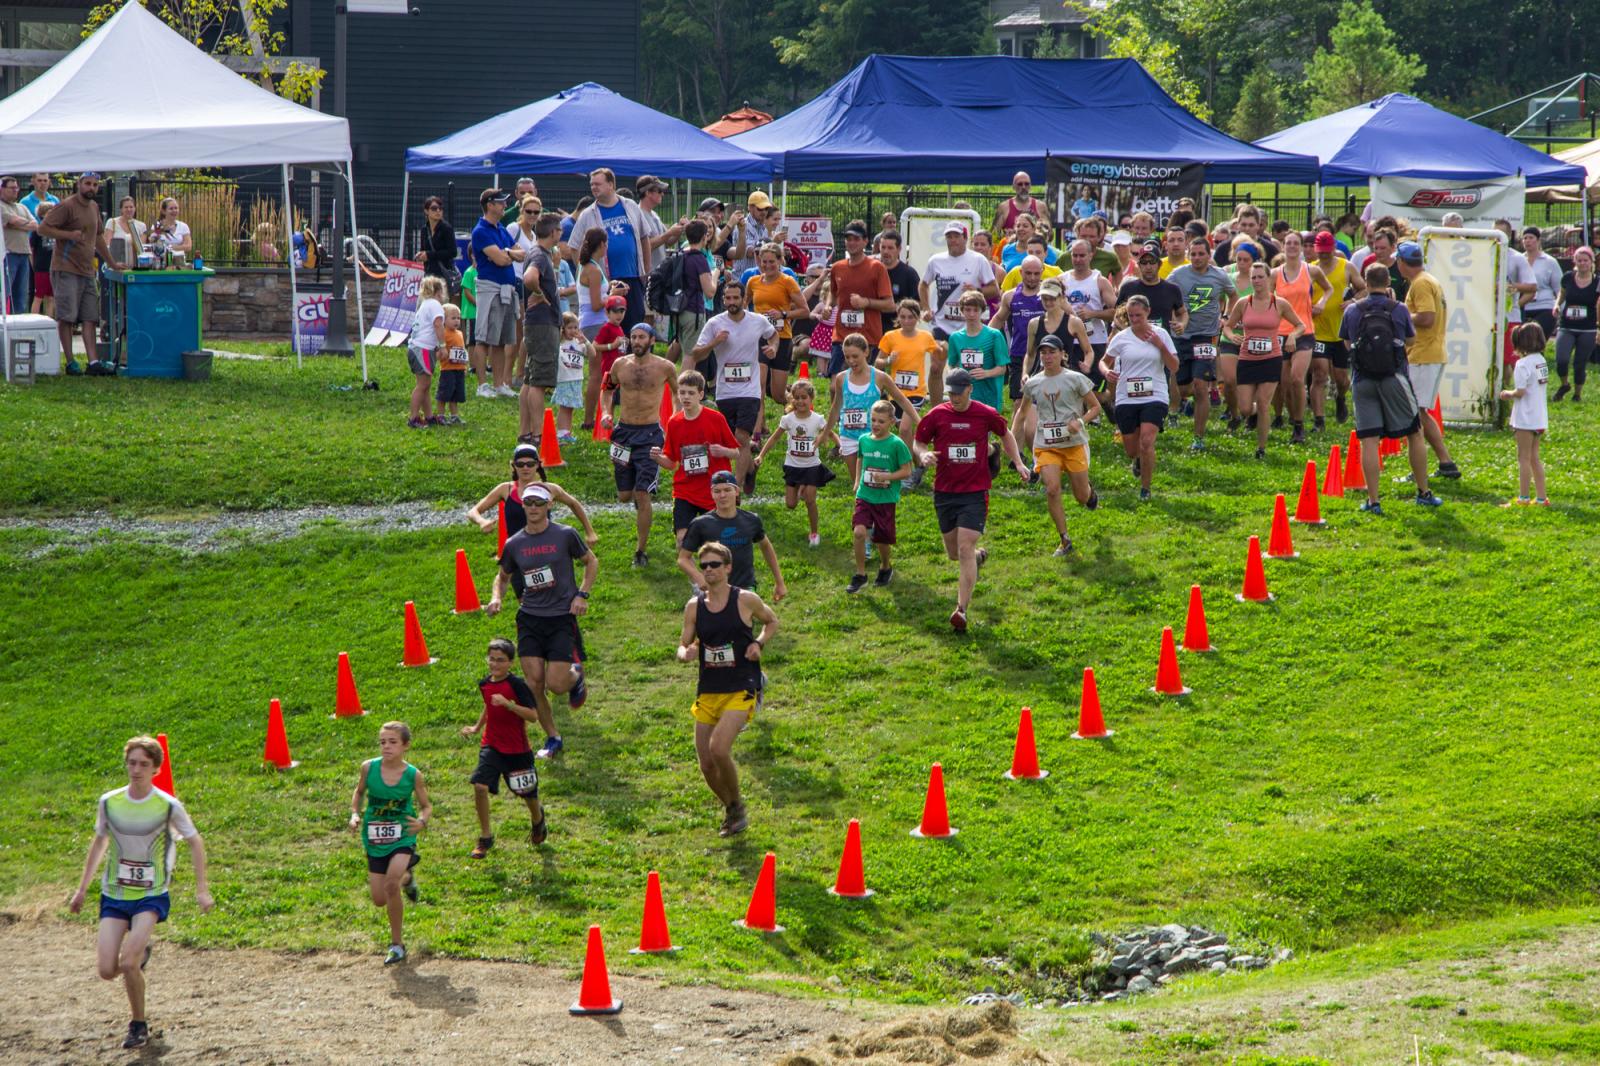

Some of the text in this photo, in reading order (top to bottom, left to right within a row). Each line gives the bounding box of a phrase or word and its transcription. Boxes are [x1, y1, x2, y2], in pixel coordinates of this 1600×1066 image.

[1071, 162, 1182, 179] energybits.com
[1132, 196, 1180, 214] bette
[1411, 191, 1473, 208] 2Toms
[800, 222, 817, 233] 60
[386, 275, 404, 294] GU
[1198, 346, 1213, 355] 142
[1252, 341, 1267, 351] 141
[567, 353, 581, 364] 122
[966, 354, 975, 363] 21
[731, 367, 742, 377] 41
[901, 375, 912, 384] 17
[1133, 382, 1144, 391] 91
[847, 413, 862, 424] 162
[1050, 428, 1062, 438] 16
[794, 441, 810, 451] 161
[612, 447, 624, 459] 37
[956, 447, 969, 458] 90
[689, 457, 701, 469] 64
[521, 544, 558, 556] TIMEX
[531, 572, 545, 585] 80
[712, 651, 725, 662] 76
[516, 773, 535, 789] 134
[374, 825, 395, 838] 135
[130, 868, 144, 880] 13
